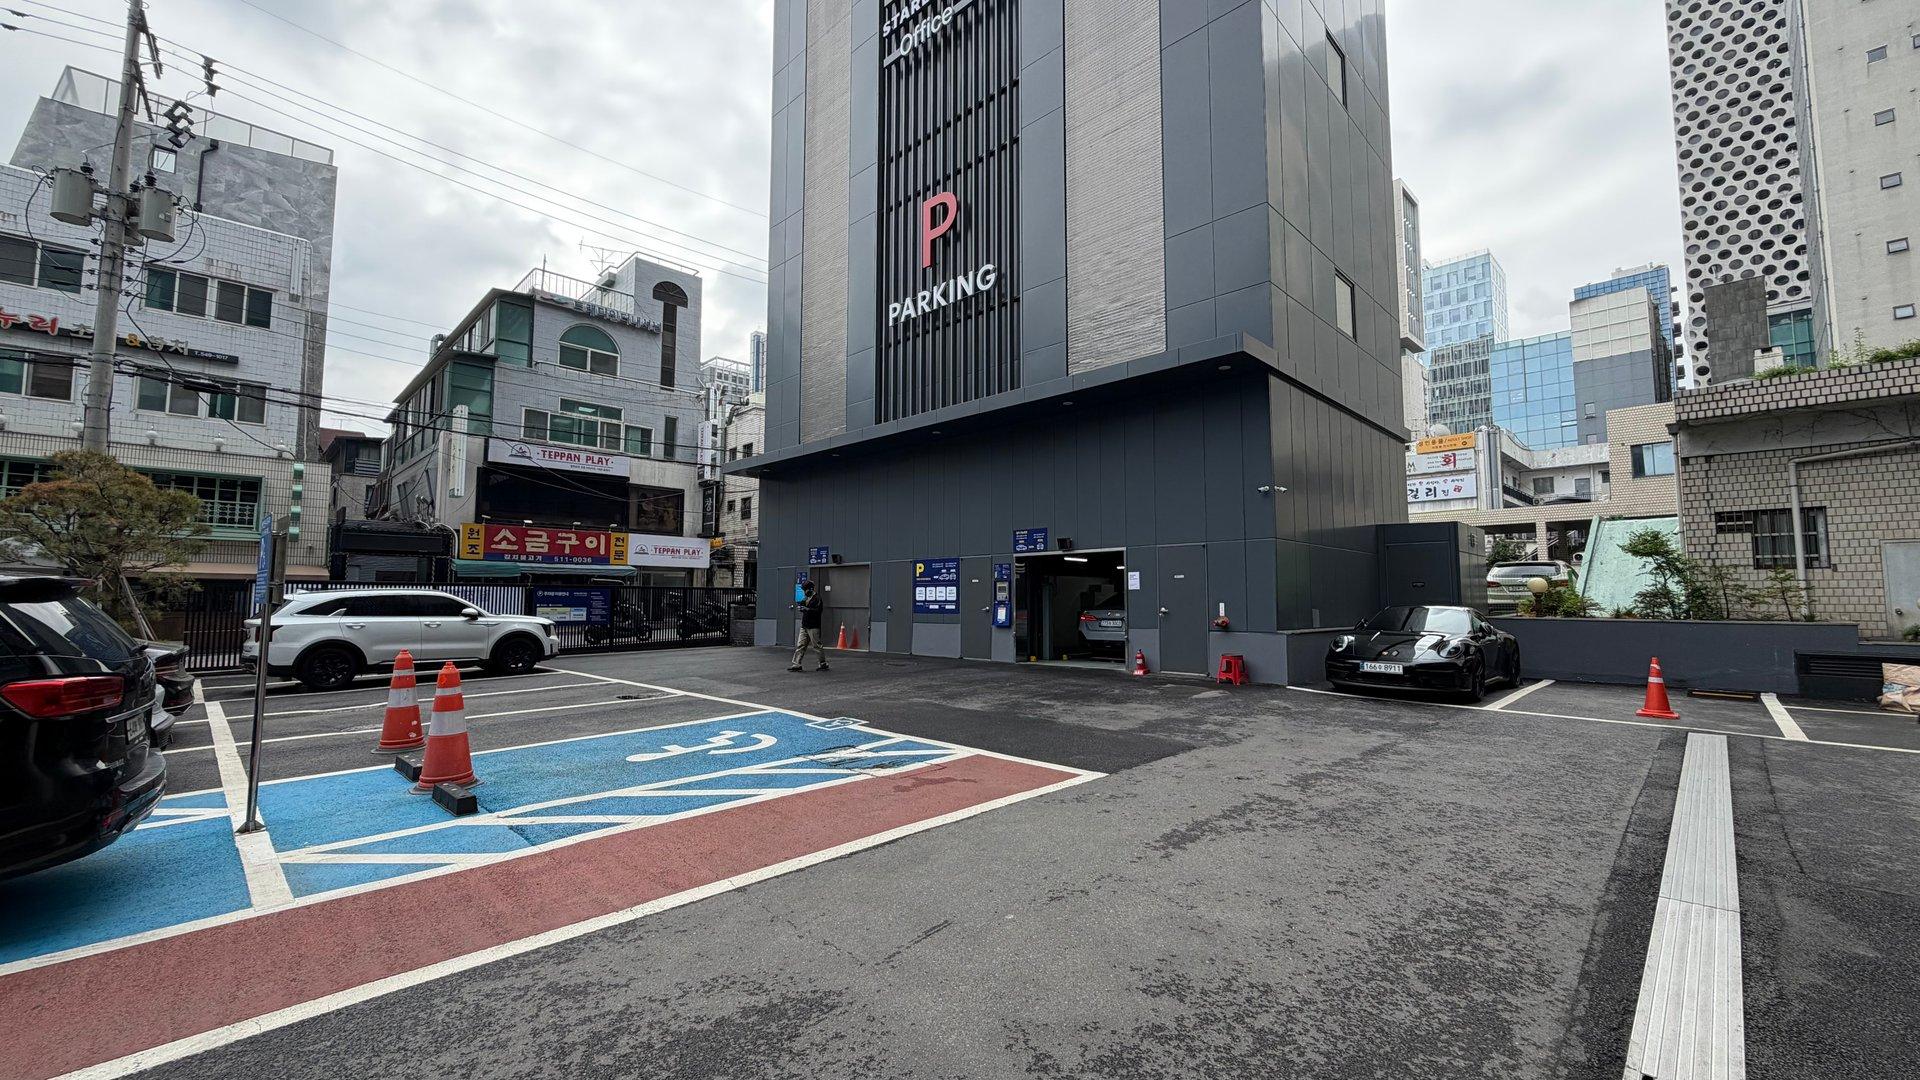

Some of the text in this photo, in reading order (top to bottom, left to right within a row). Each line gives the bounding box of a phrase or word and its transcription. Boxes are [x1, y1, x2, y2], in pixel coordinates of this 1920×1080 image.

[900, 6, 953, 56] Office
[922, 191, 959, 269] P
[888, 263, 998, 327] PARKING
[540, 449, 611, 466] TEPPAN PLAY
[467, 527, 480, 555] 원조
[490, 528, 606, 555] 소금구이
[654, 547, 701, 556] TEPPAN PLAY
[916, 563, 925, 577] P
